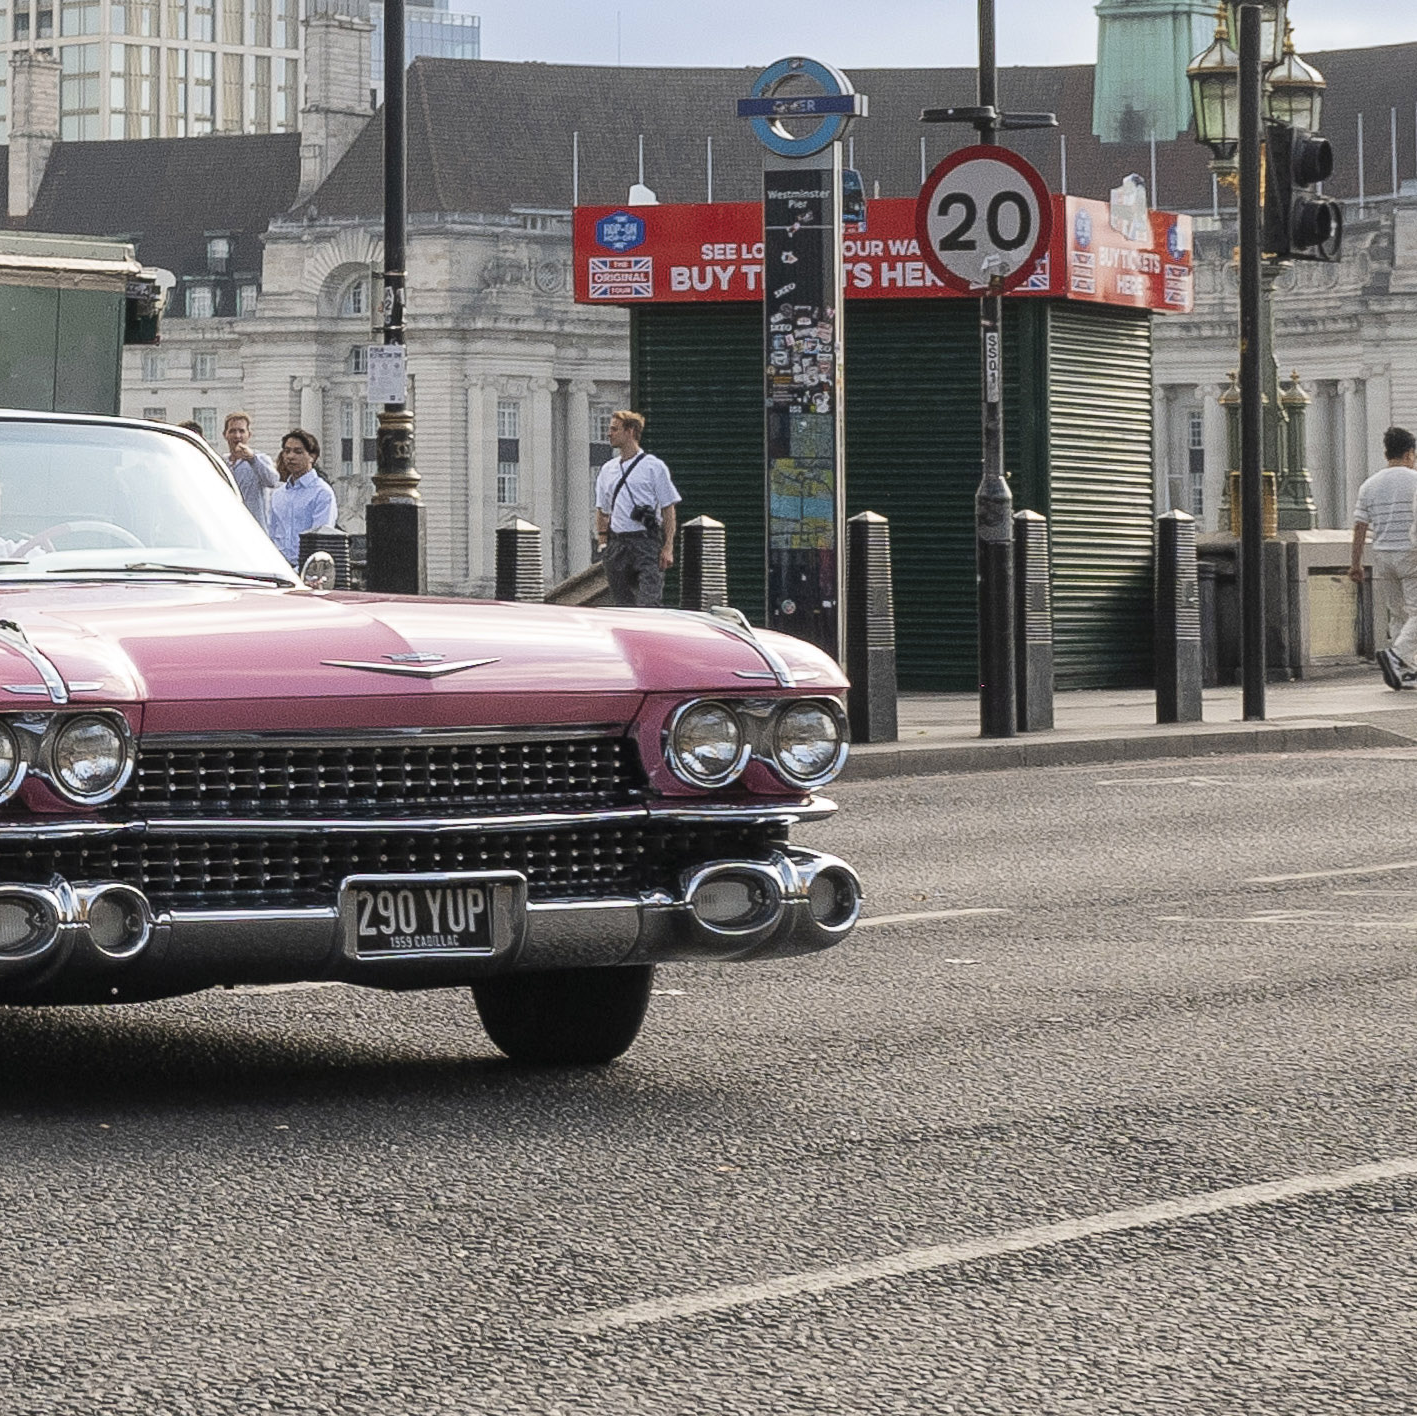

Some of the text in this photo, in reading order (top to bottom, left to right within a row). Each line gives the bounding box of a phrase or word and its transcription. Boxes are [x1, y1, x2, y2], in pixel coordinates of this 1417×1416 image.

[766, 188, 831, 200] Westminster
[788, 199, 808, 209] Pier
[937, 190, 1032, 252] 20
[700, 242, 738, 261] SEE
[594, 272, 648, 283] ORIGINAL
[669, 264, 736, 292] BUY
[358, 888, 485, 936] 290 YUP
[414, 934, 460, 948] CADILLAC
